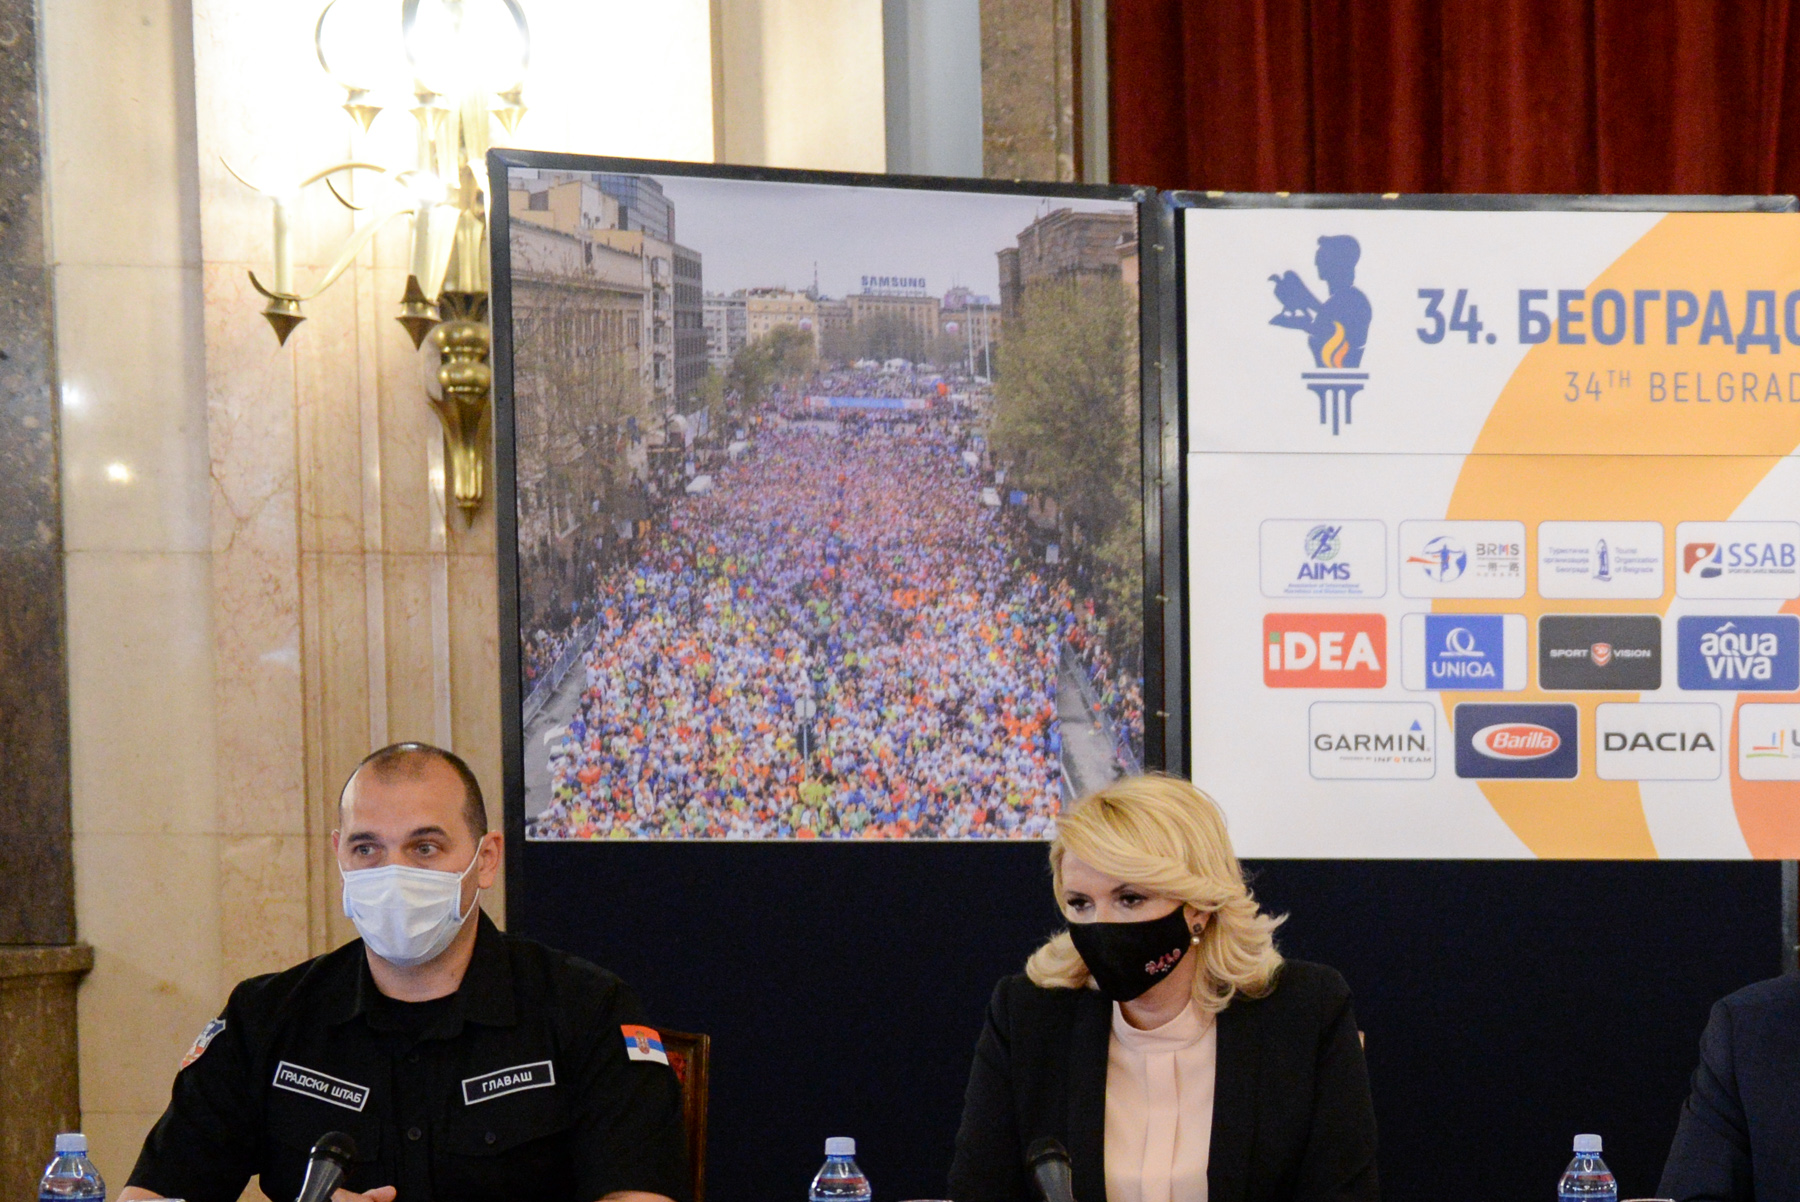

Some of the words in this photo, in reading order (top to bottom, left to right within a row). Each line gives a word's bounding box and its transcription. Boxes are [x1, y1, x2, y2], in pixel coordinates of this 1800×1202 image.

[861, 275, 926, 288] SAMSUNG
[1416, 288, 1497, 345] 34.
[1477, 543, 1519, 556] BRMS
[1728, 543, 1796, 567] SSAB
[1297, 562, 1351, 580] AIMS
[1550, 649, 1588, 657] SPORT
[1614, 649, 1651, 657] VISION
[1432, 661, 1495, 678] UNIQA
[1705, 656, 1772, 679] viva
[1314, 733, 1425, 751] GARMIN
[1493, 732, 1554, 750] Barilla
[1604, 732, 1715, 751] DACIA
[280, 1069, 329, 1093] ГРАДСКИ
[330, 1085, 362, 1104] ШТАБ
[482, 1071, 533, 1093] ГЛАВАШ
